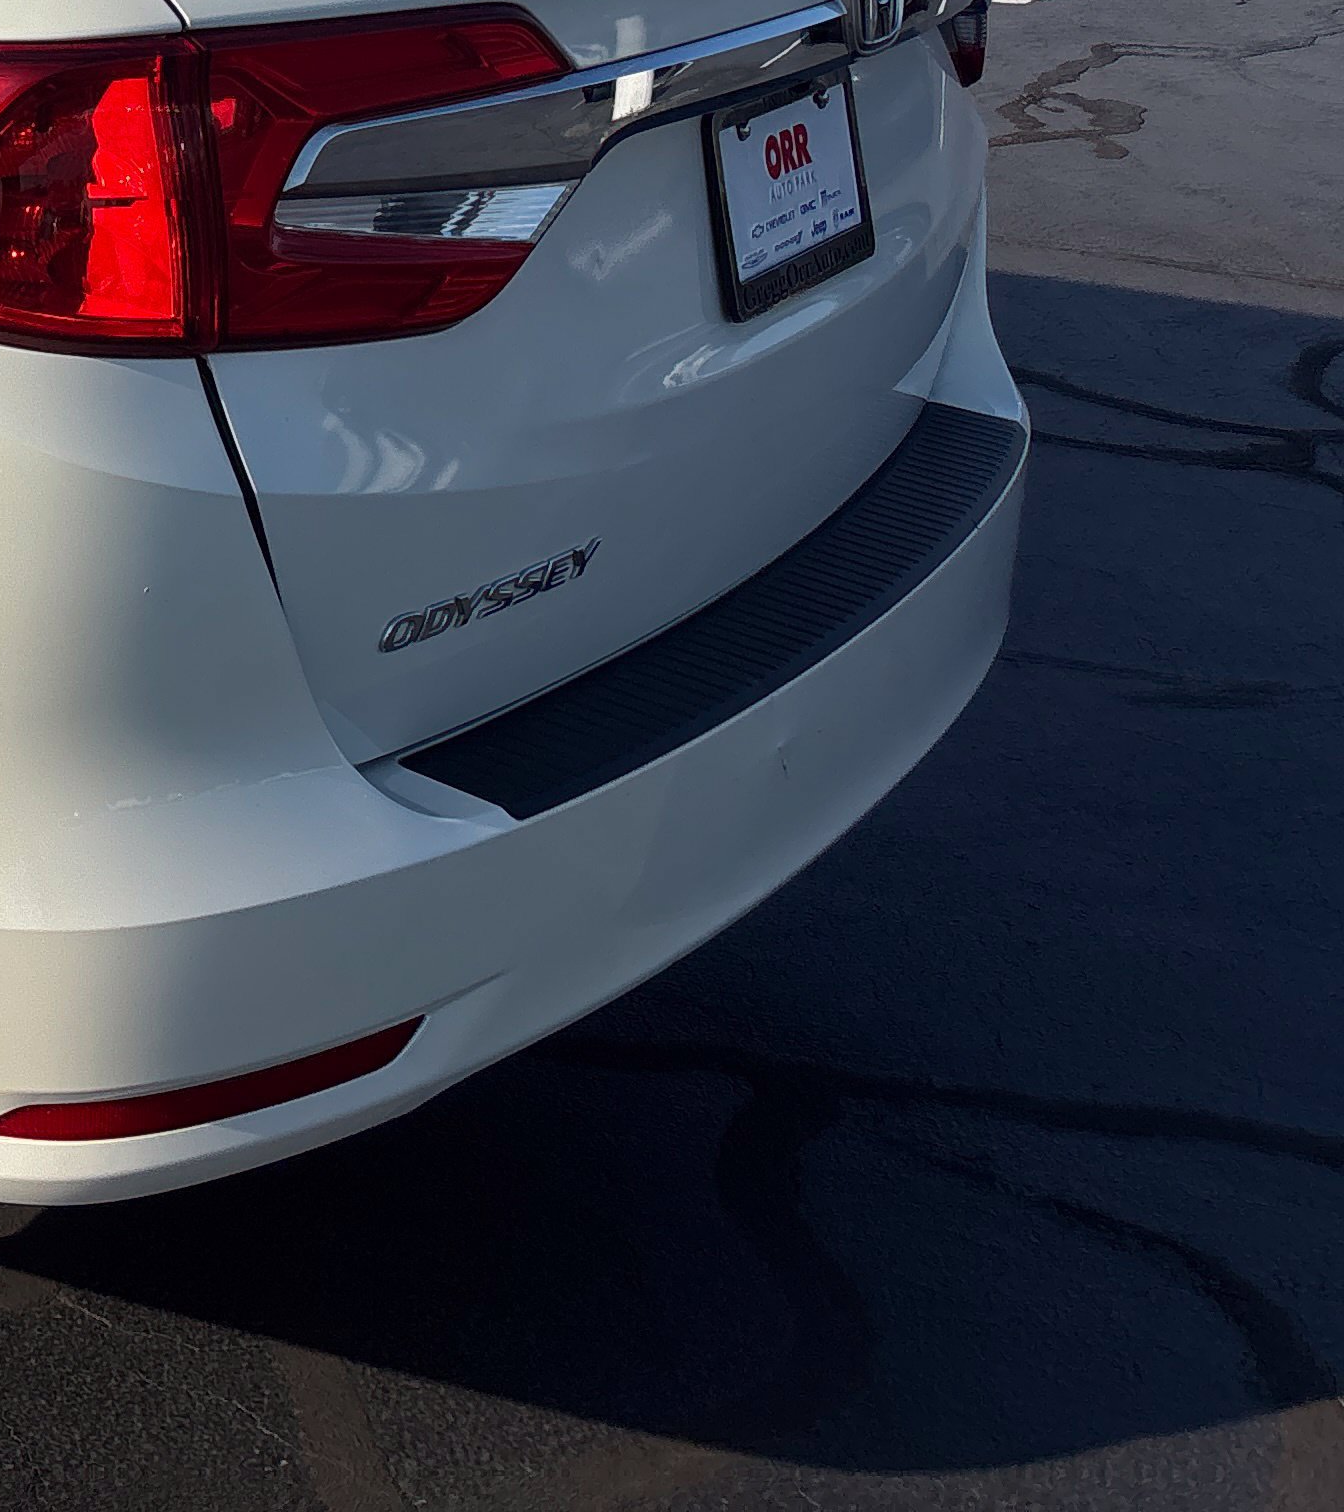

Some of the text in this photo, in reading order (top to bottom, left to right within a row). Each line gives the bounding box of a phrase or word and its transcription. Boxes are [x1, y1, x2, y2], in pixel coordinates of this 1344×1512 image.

[765, 123, 812, 180] ORR
[769, 169, 817, 204] AUTO PARK
[765, 209, 795, 232] CHEVROLET
[742, 234, 872, 311] GreggOrrAuto.com
[378, 536, 604, 653] ODYSSEY
